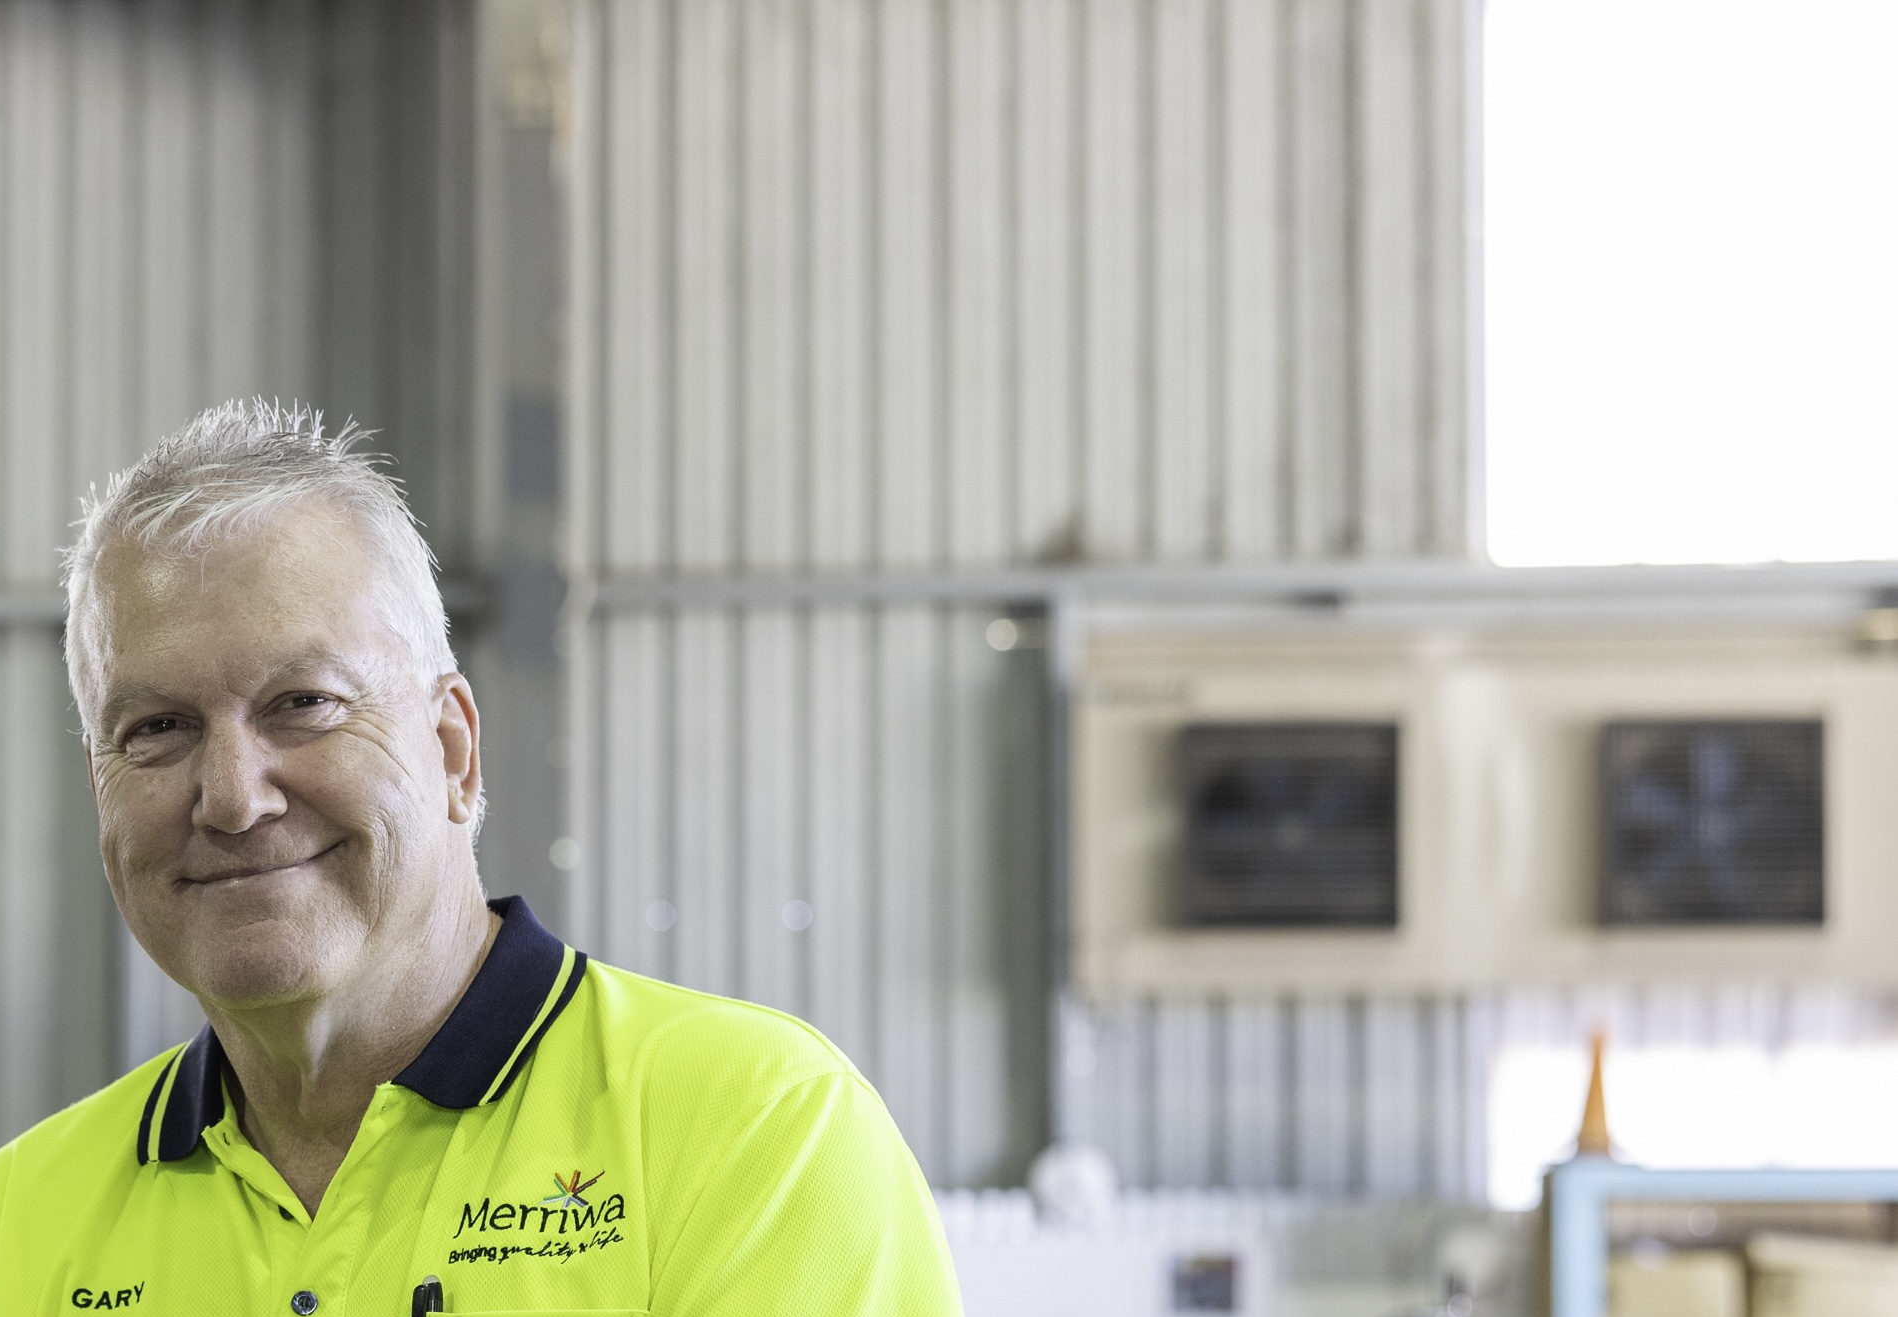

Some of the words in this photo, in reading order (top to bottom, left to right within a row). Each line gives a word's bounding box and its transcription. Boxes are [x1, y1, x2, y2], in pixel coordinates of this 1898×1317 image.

[453, 1194, 626, 1239] Merriwa
[448, 1245, 497, 1264] Bringing
[498, 1241, 577, 1264] quality
[589, 1227, 625, 1249] life
[71, 1281, 145, 1310] GARY
